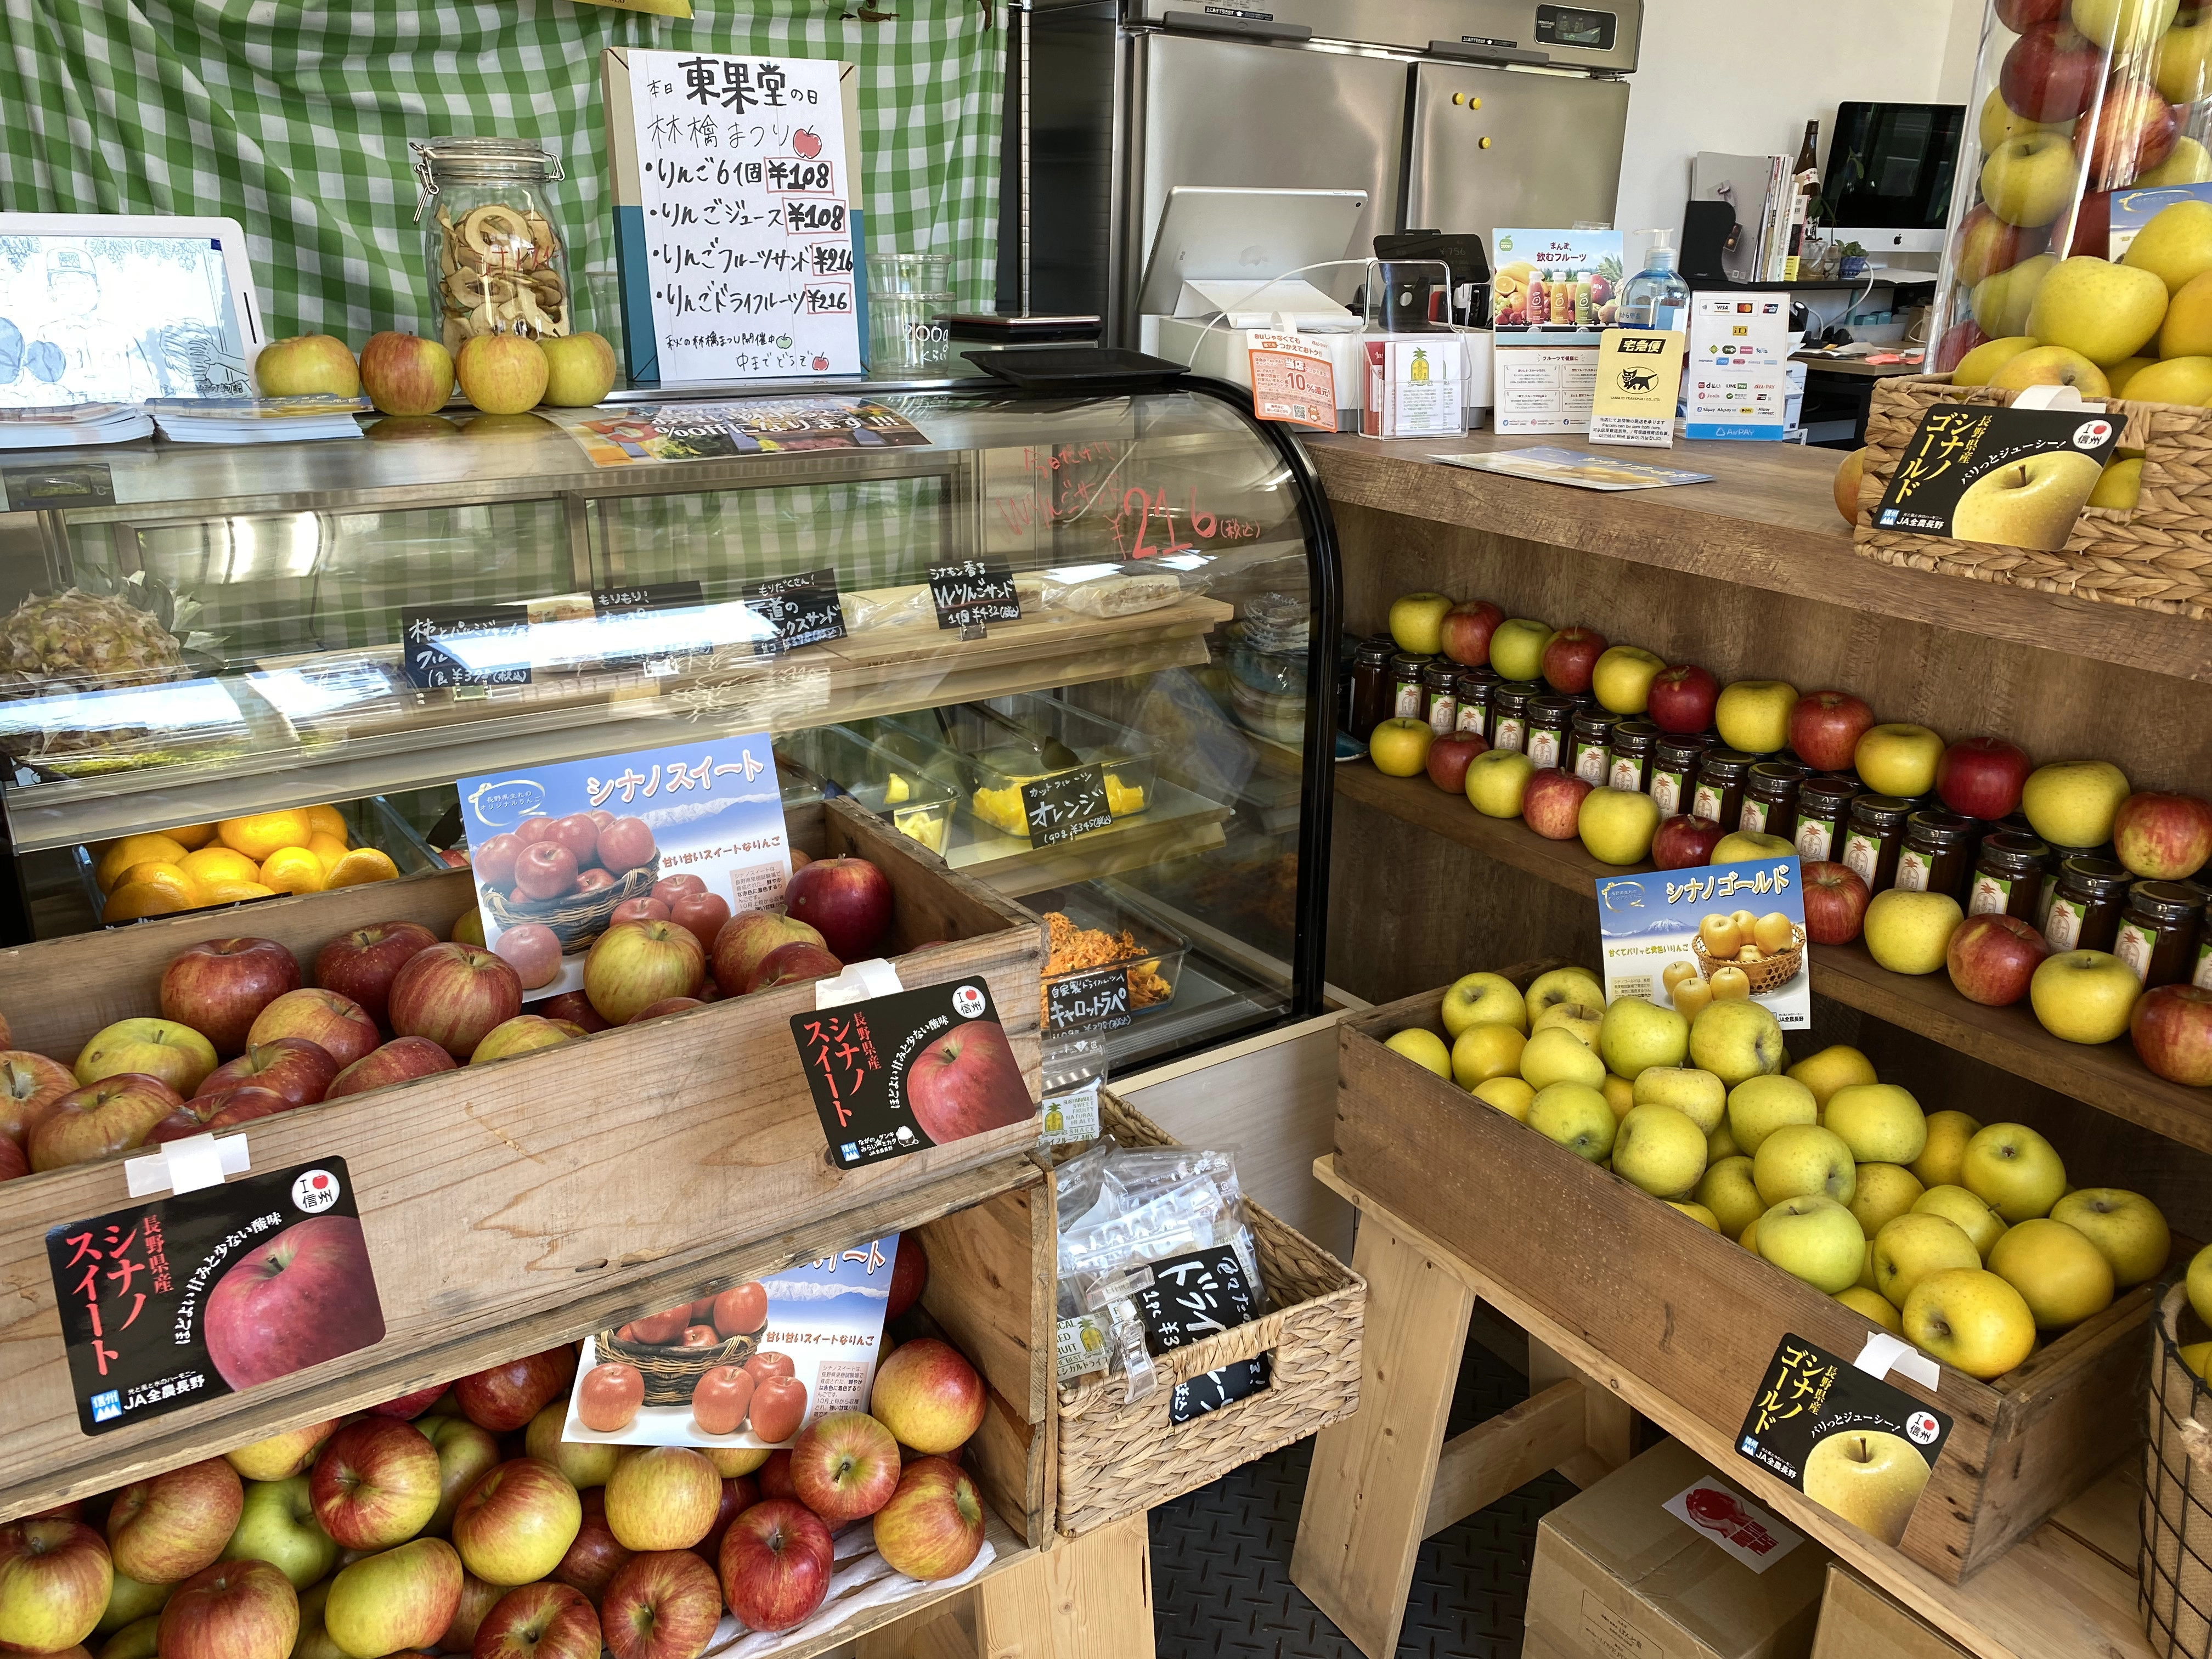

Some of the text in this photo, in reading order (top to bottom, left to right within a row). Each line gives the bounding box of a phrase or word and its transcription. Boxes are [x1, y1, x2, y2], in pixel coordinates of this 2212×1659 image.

[1536, 252, 1587, 262] 飲むフルーツ
[1623, 339, 1662, 353] 宅急便
[1285, 358, 1306, 373] 当店
[1287, 373, 1306, 391] 10
[1726, 428, 1755, 436] AirPAY
[1957, 414, 1994, 465] 長野県産
[2076, 433, 2103, 446] 信州
[1894, 412, 1958, 504] ゴールド
[1922, 411, 1978, 482] シナノ
[1960, 439, 2068, 486] パリっとジューシー!
[1896, 517, 1945, 529] JA全農長野
[929, 560, 986, 579] シナモン香る
[759, 574, 815, 596] もりだくさん!
[774, 604, 842, 637] ックスサンド
[586, 749, 764, 808] シナノスイート
[1029, 772, 1092, 797] カットフルーツ
[479, 795, 541, 811] オリジナルりんご
[1029, 788, 1104, 827] オレンジ
[662, 835, 781, 868] 甘い甘いスイートなりんご
[736, 871, 781, 885] 長野県果樹試験場で
[737, 884, 783, 898] な赤色に着色するり
[1666, 864, 1790, 904] シナノゴールド
[1608, 943, 1689, 957] 甘くてパリッと黄色いりんご
[960, 1000, 983, 1014] 信州
[1049, 987, 1127, 1028] キャロットラペ
[853, 1011, 883, 1071] 長野県産
[828, 1017, 865, 1096] シナノ
[887, 1014, 950, 1109] ほどよい甘みと少ない酸味
[803, 1020, 853, 1128] スイート
[1066, 1112, 1095, 1120] NATURAL
[1073, 1101, 1094, 1109] SWEET
[302, 1189, 334, 1210] 信州
[143, 1214, 174, 1295] 長野県産
[103, 1225, 147, 1332] シナノ
[174, 1211, 284, 1345] ほどよい甘みと少ない酸味
[65, 1232, 120, 1376] スイート
[765, 1330, 874, 1347] 甘い甘いスイートなりんご
[1057, 1342, 1077, 1355] RUIT
[1065, 1355, 1082, 1363] BEST
[92, 1391, 119, 1408] 信州
[123, 1374, 205, 1410] JA全農長野
[1754, 1345, 1809, 1435] ゴールド
[1778, 1355, 1825, 1420] シナノ
[1807, 1364, 1838, 1416] 長野県産
[1810, 1411, 1901, 1438] パリっとジューシー!
[1909, 1425, 1932, 1443] 信州
[1755, 1451, 1798, 1479] JA全農長野
